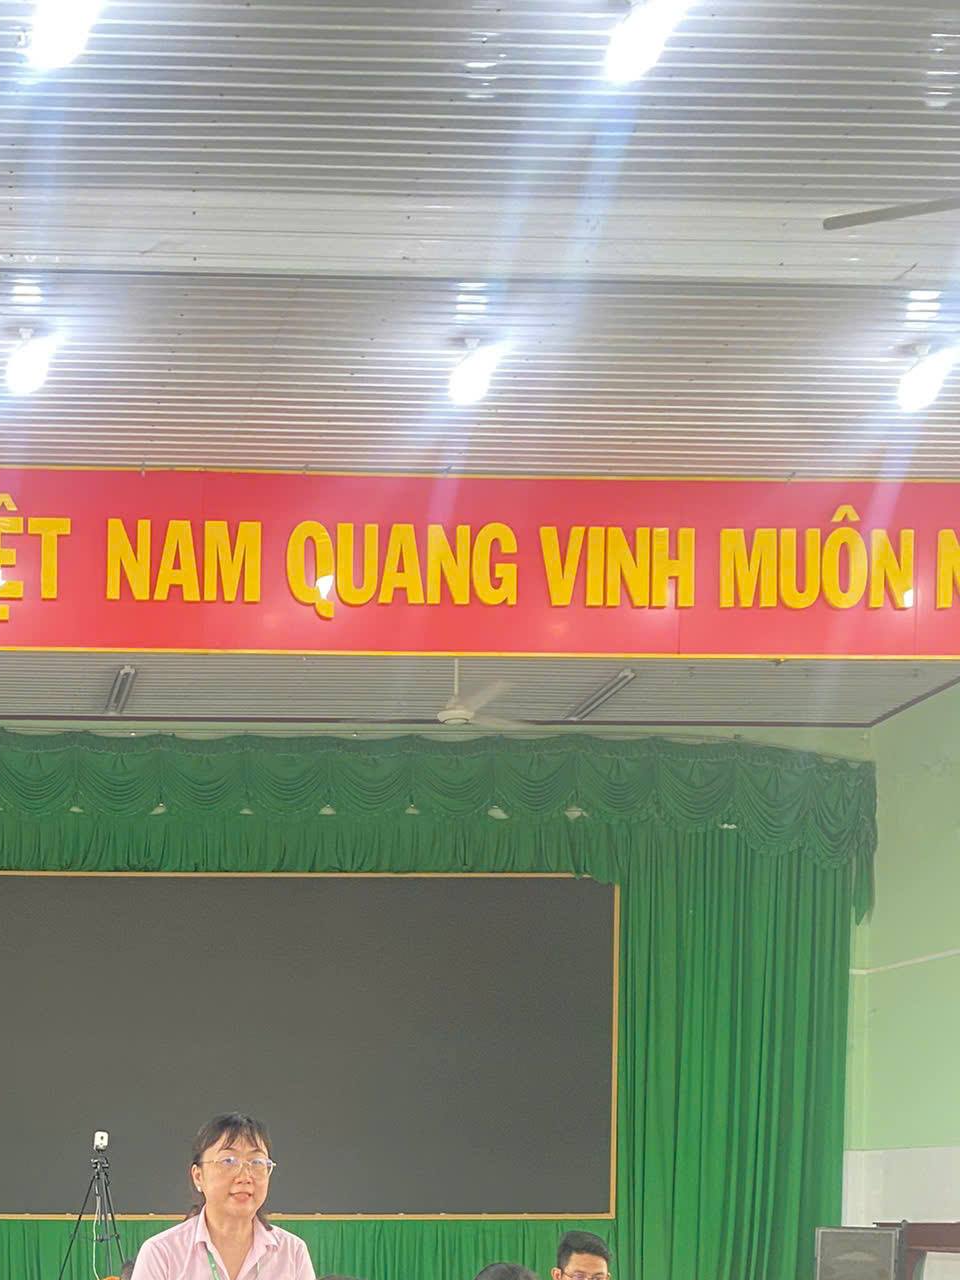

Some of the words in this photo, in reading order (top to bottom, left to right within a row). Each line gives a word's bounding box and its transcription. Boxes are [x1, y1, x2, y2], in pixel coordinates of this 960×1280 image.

[106, 517, 262, 603] NAM
[285, 520, 517, 619] QUANG
[539, 525, 695, 609] VINH
[719, 505, 914, 609] MUÔN
